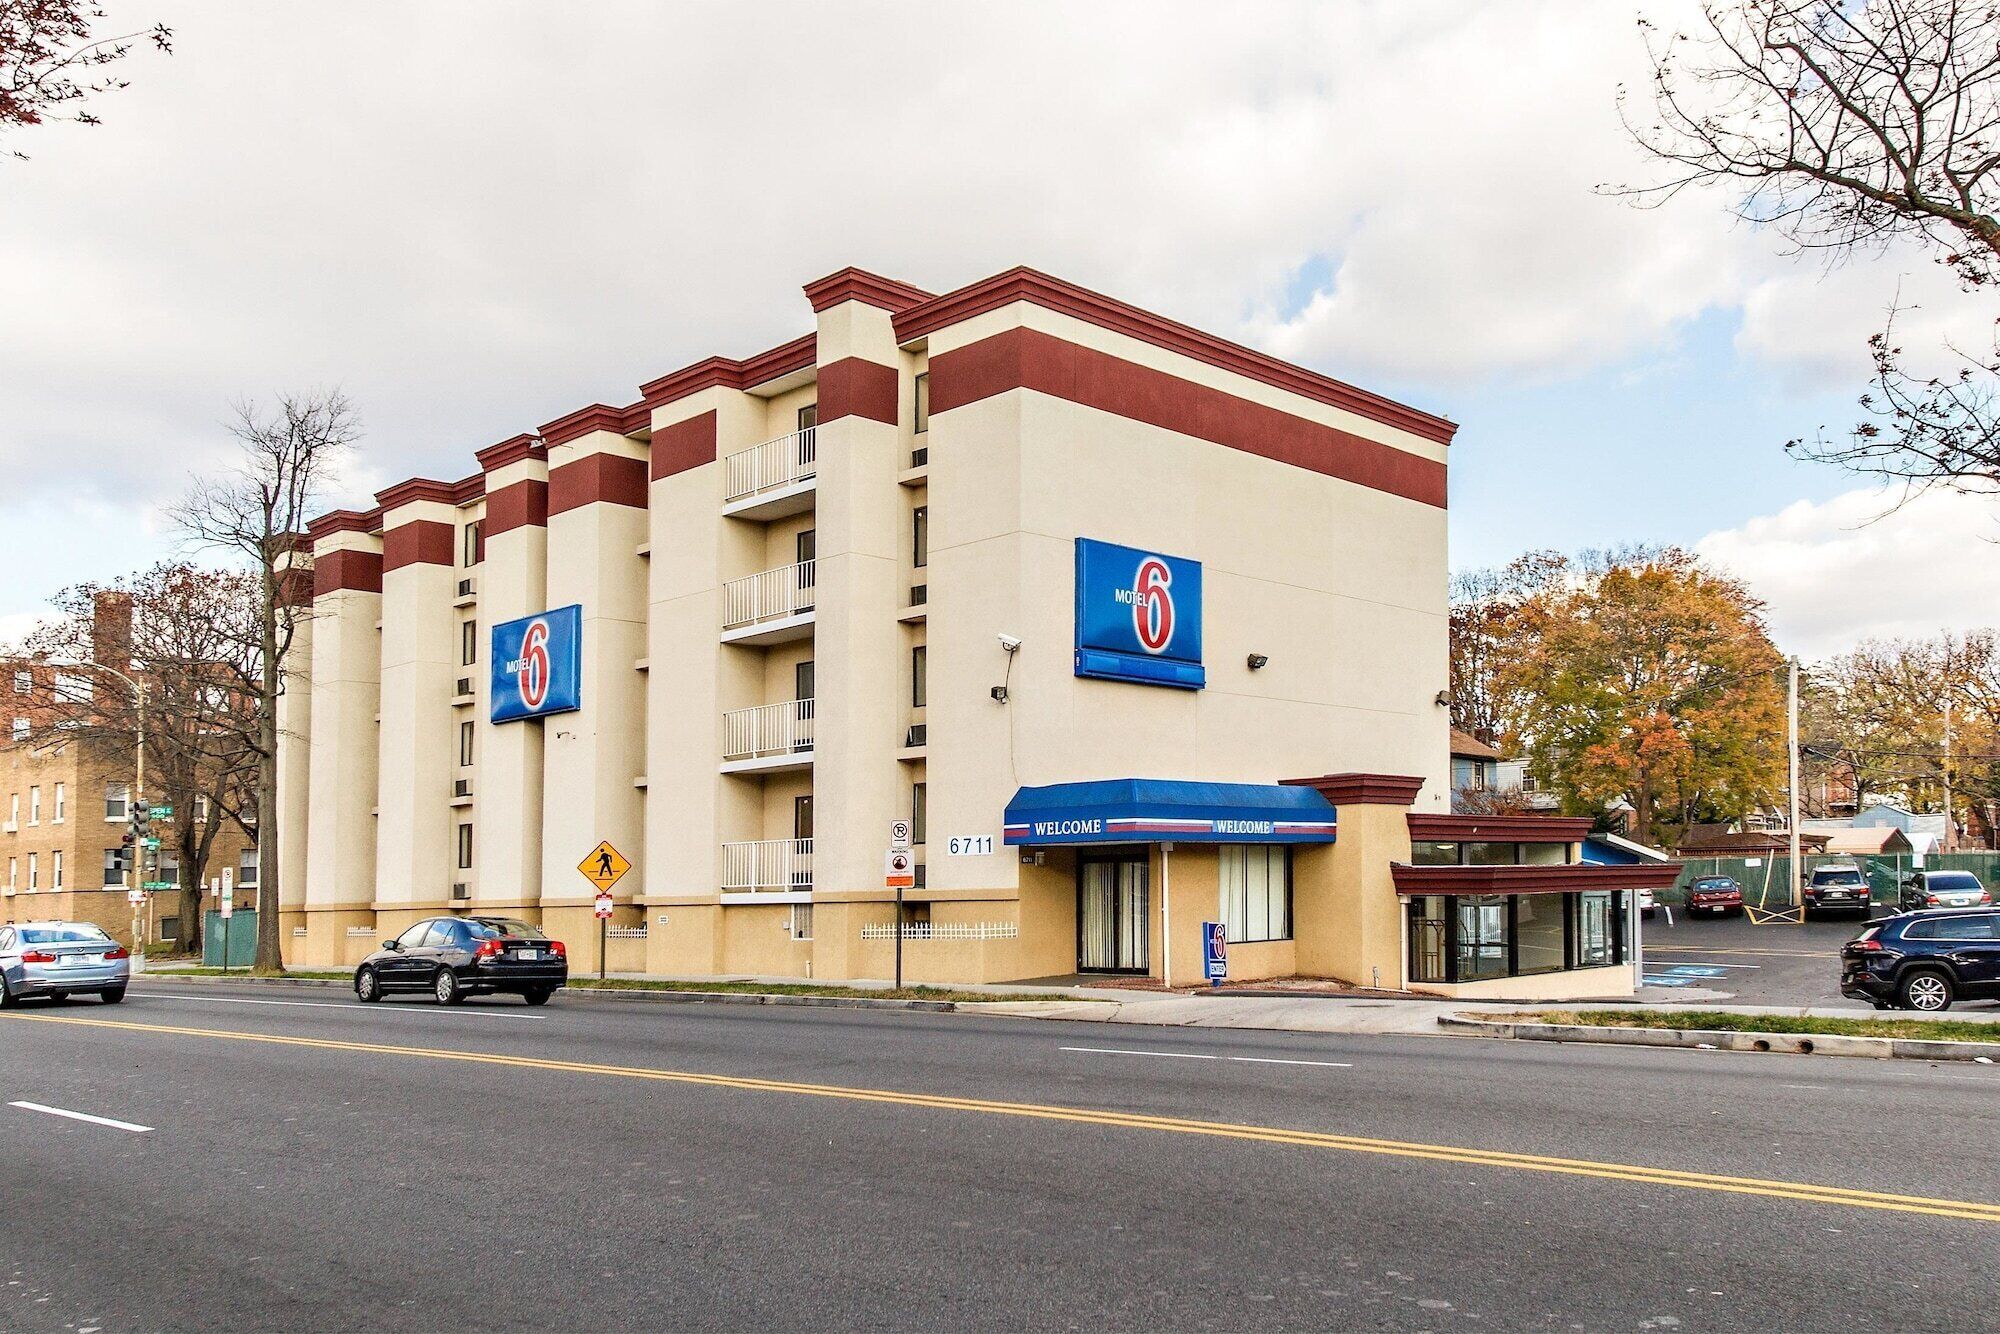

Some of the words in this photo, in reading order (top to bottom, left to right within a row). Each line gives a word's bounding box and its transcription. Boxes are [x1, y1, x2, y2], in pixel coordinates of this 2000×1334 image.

[1115, 589, 1148, 607] MOTEL
[1134, 557, 1175, 652] 6
[506, 657, 530, 673] MOTEL
[519, 619, 549, 710] 6
[1034, 819, 1102, 836] WELCOME
[1216, 820, 1270, 834] WELCOME
[950, 837, 992, 854] 6711
[1214, 925, 1226, 959] 6
